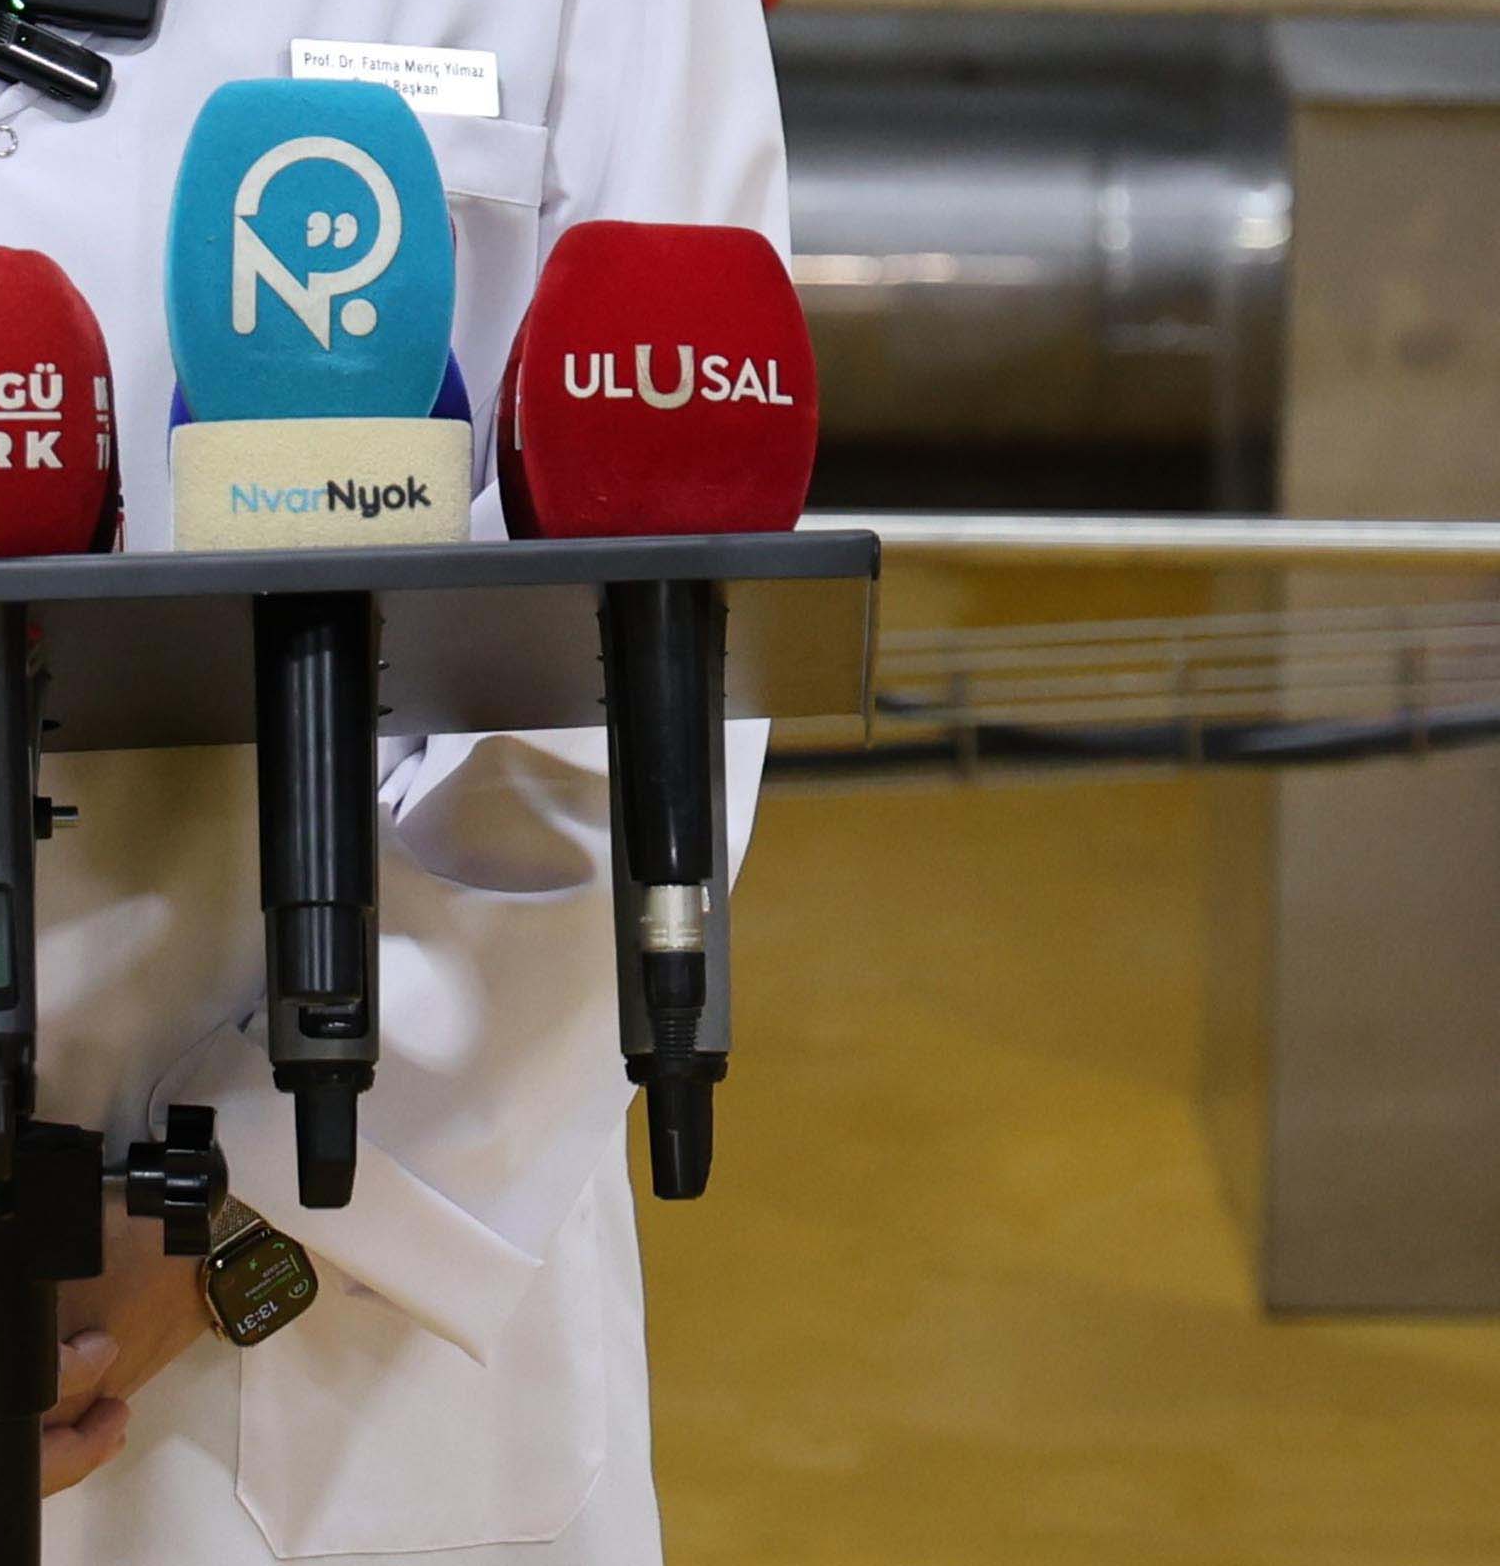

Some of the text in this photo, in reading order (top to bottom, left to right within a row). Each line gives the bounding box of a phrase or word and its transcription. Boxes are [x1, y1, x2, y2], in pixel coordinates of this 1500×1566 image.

[304, 51, 335, 68] Prof.
[362, 56, 400, 74] Fatma
[393, 78, 439, 97] Başkan
[564, 344, 794, 409] ULUSAL
[236, 1300, 279, 1335] 13:31
